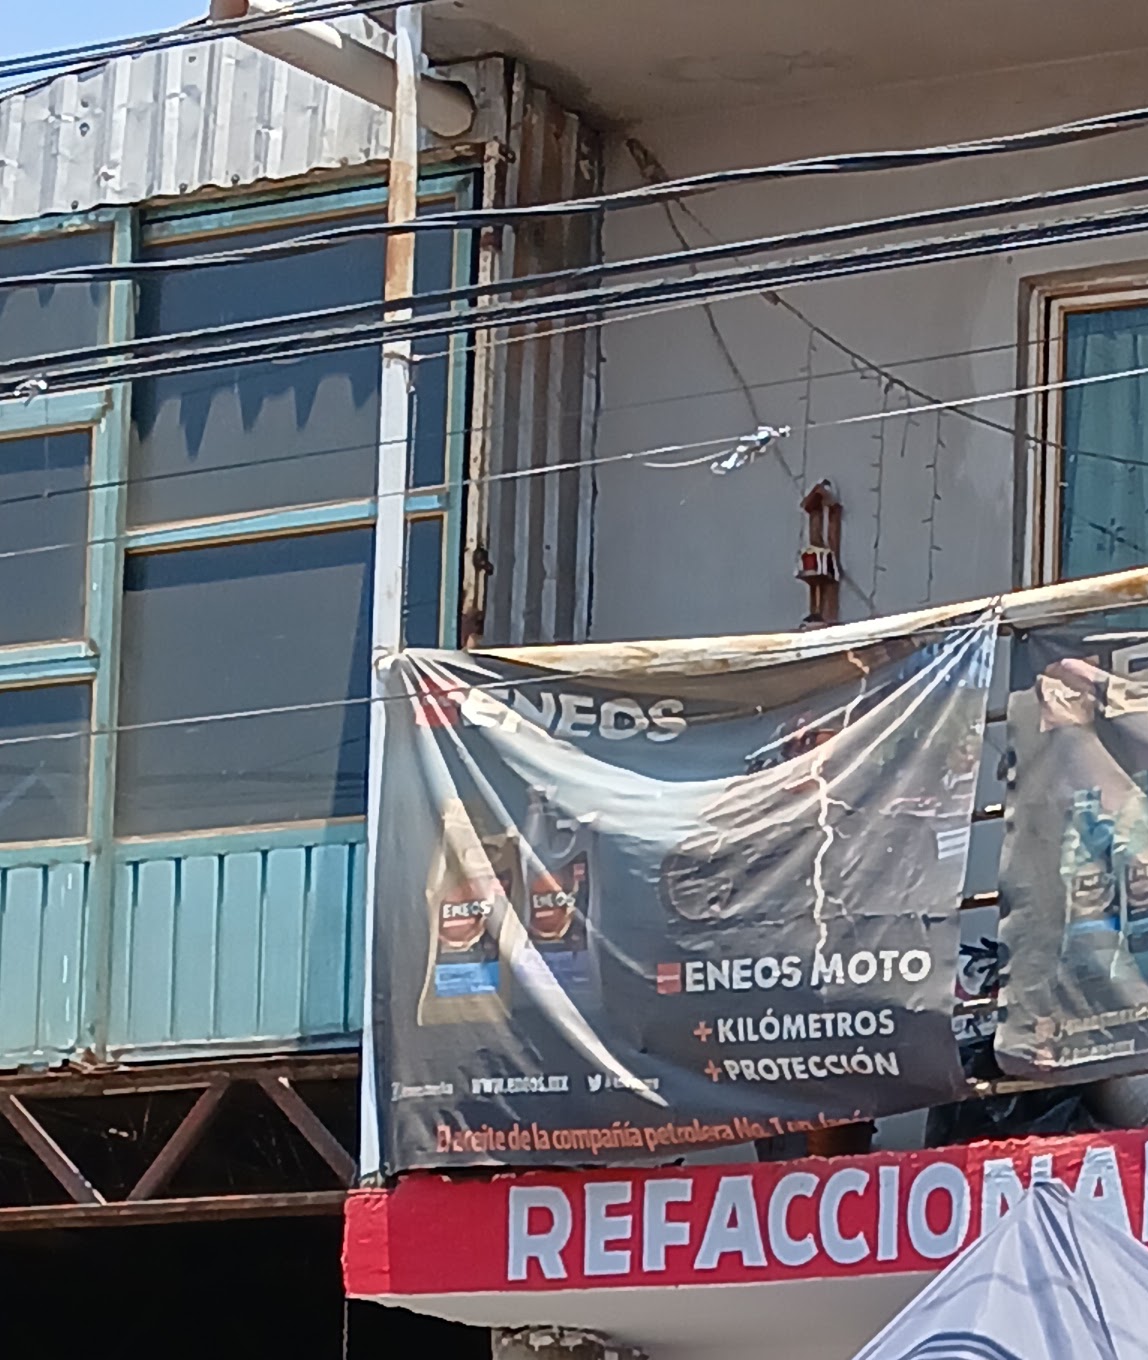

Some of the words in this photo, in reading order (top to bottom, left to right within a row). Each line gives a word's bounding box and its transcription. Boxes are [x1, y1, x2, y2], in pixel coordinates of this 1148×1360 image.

[461, 688, 687, 742] ENEOS
[685, 955, 802, 993] ENEOS
[810, 949, 932, 987] MOTO
[508, 1123, 531, 1150] de
[533, 1122, 550, 1149] la
[552, 1121, 642, 1154] compañía
[645, 1118, 734, 1152] petrolera
